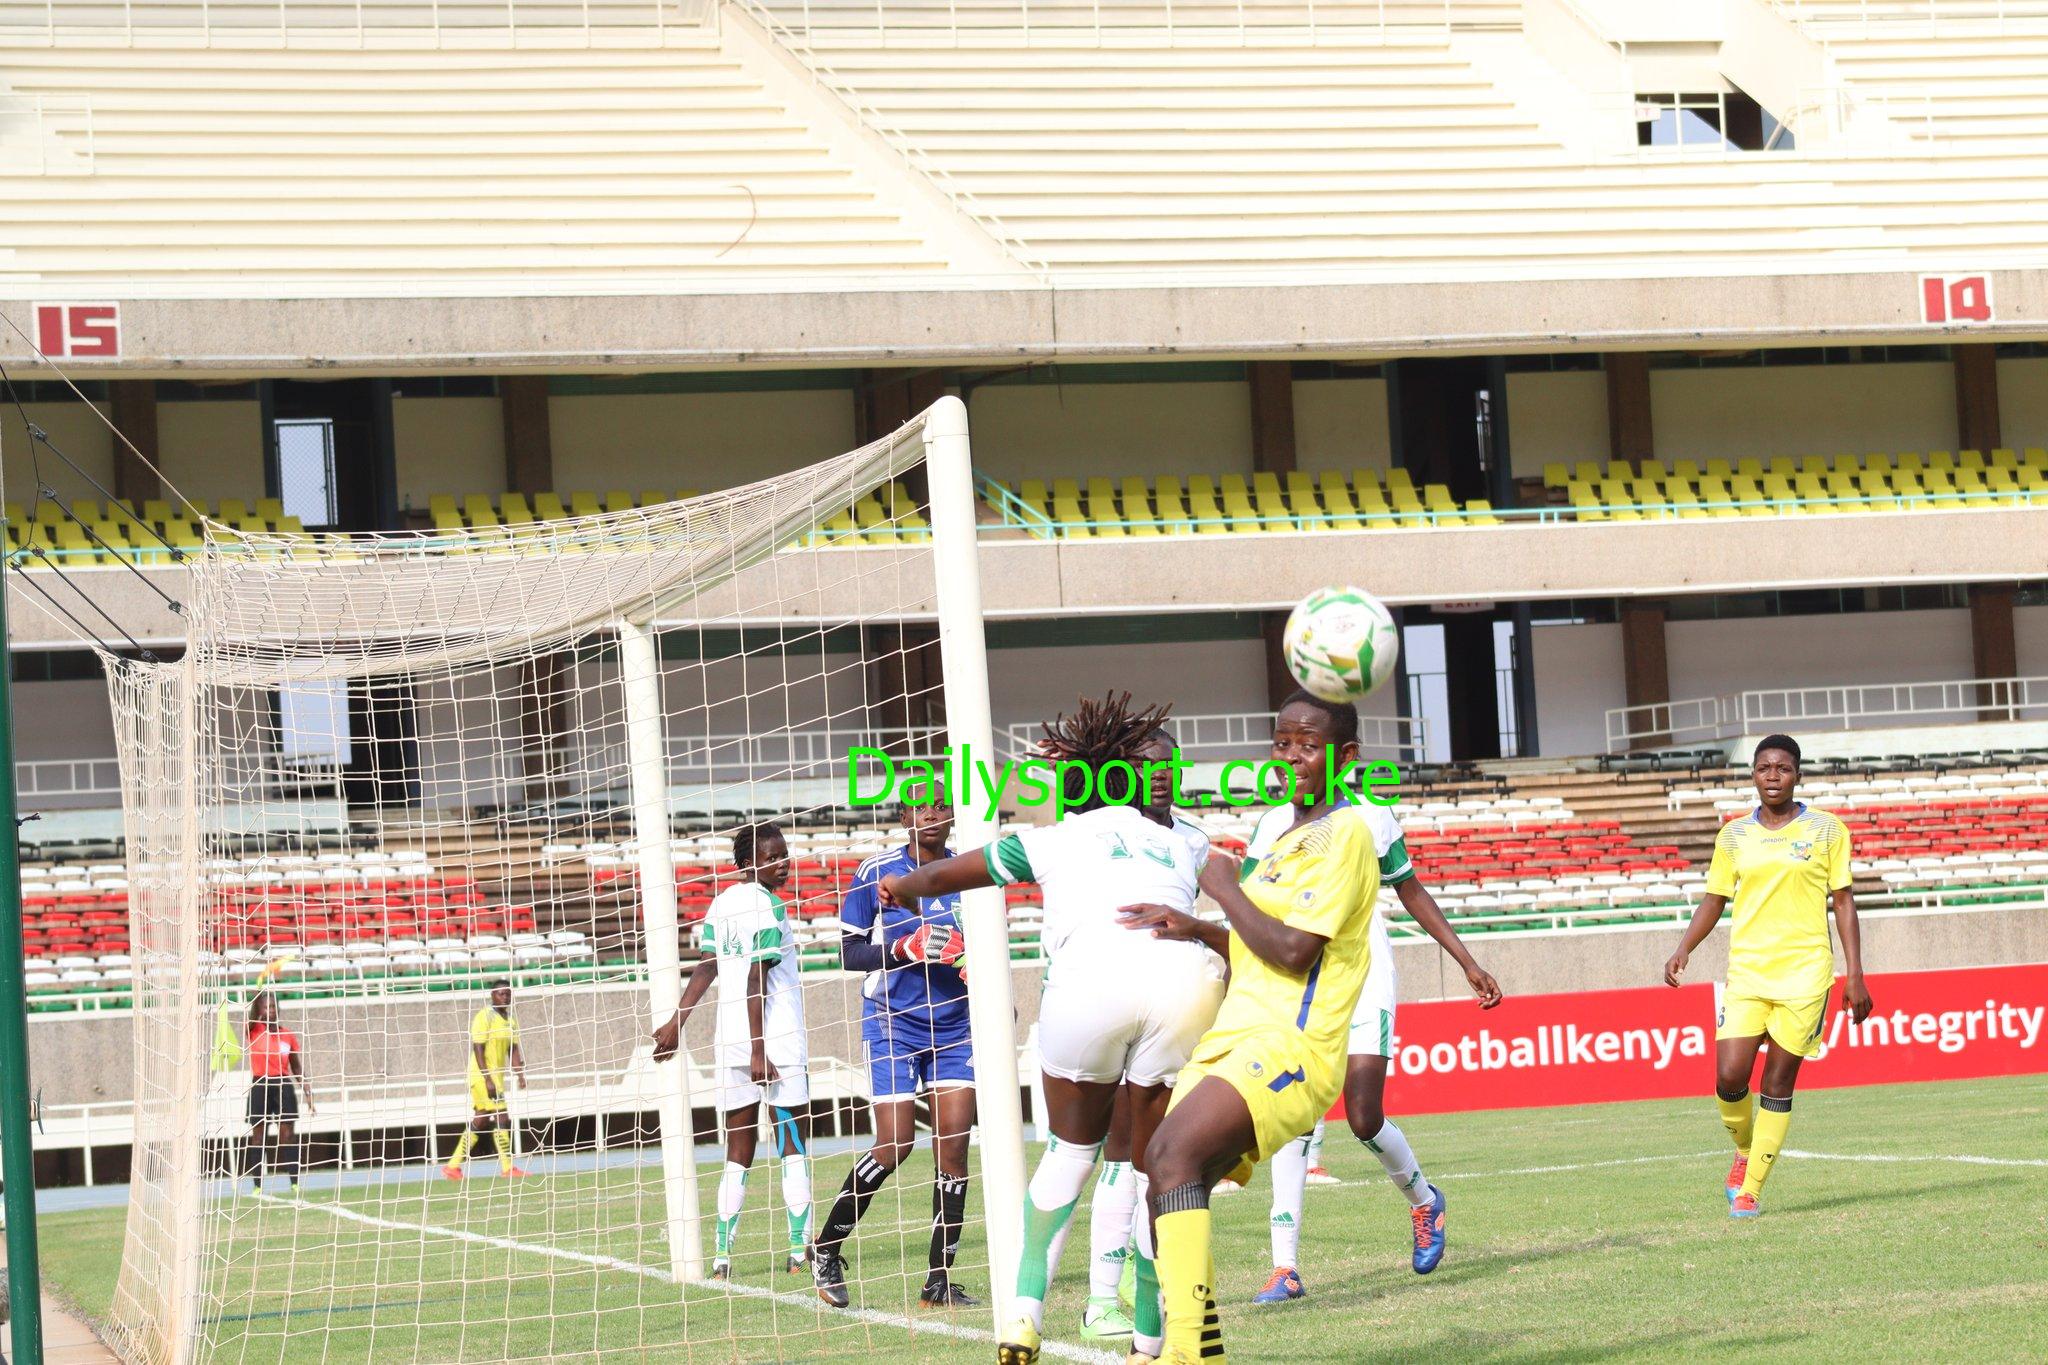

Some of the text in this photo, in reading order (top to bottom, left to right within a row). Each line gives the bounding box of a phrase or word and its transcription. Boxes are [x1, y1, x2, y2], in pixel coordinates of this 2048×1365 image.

[38, 307, 117, 356] 15
[1386, 1023, 1706, 1077] footballkenya
[1100, 1256, 1126, 1264] adida
